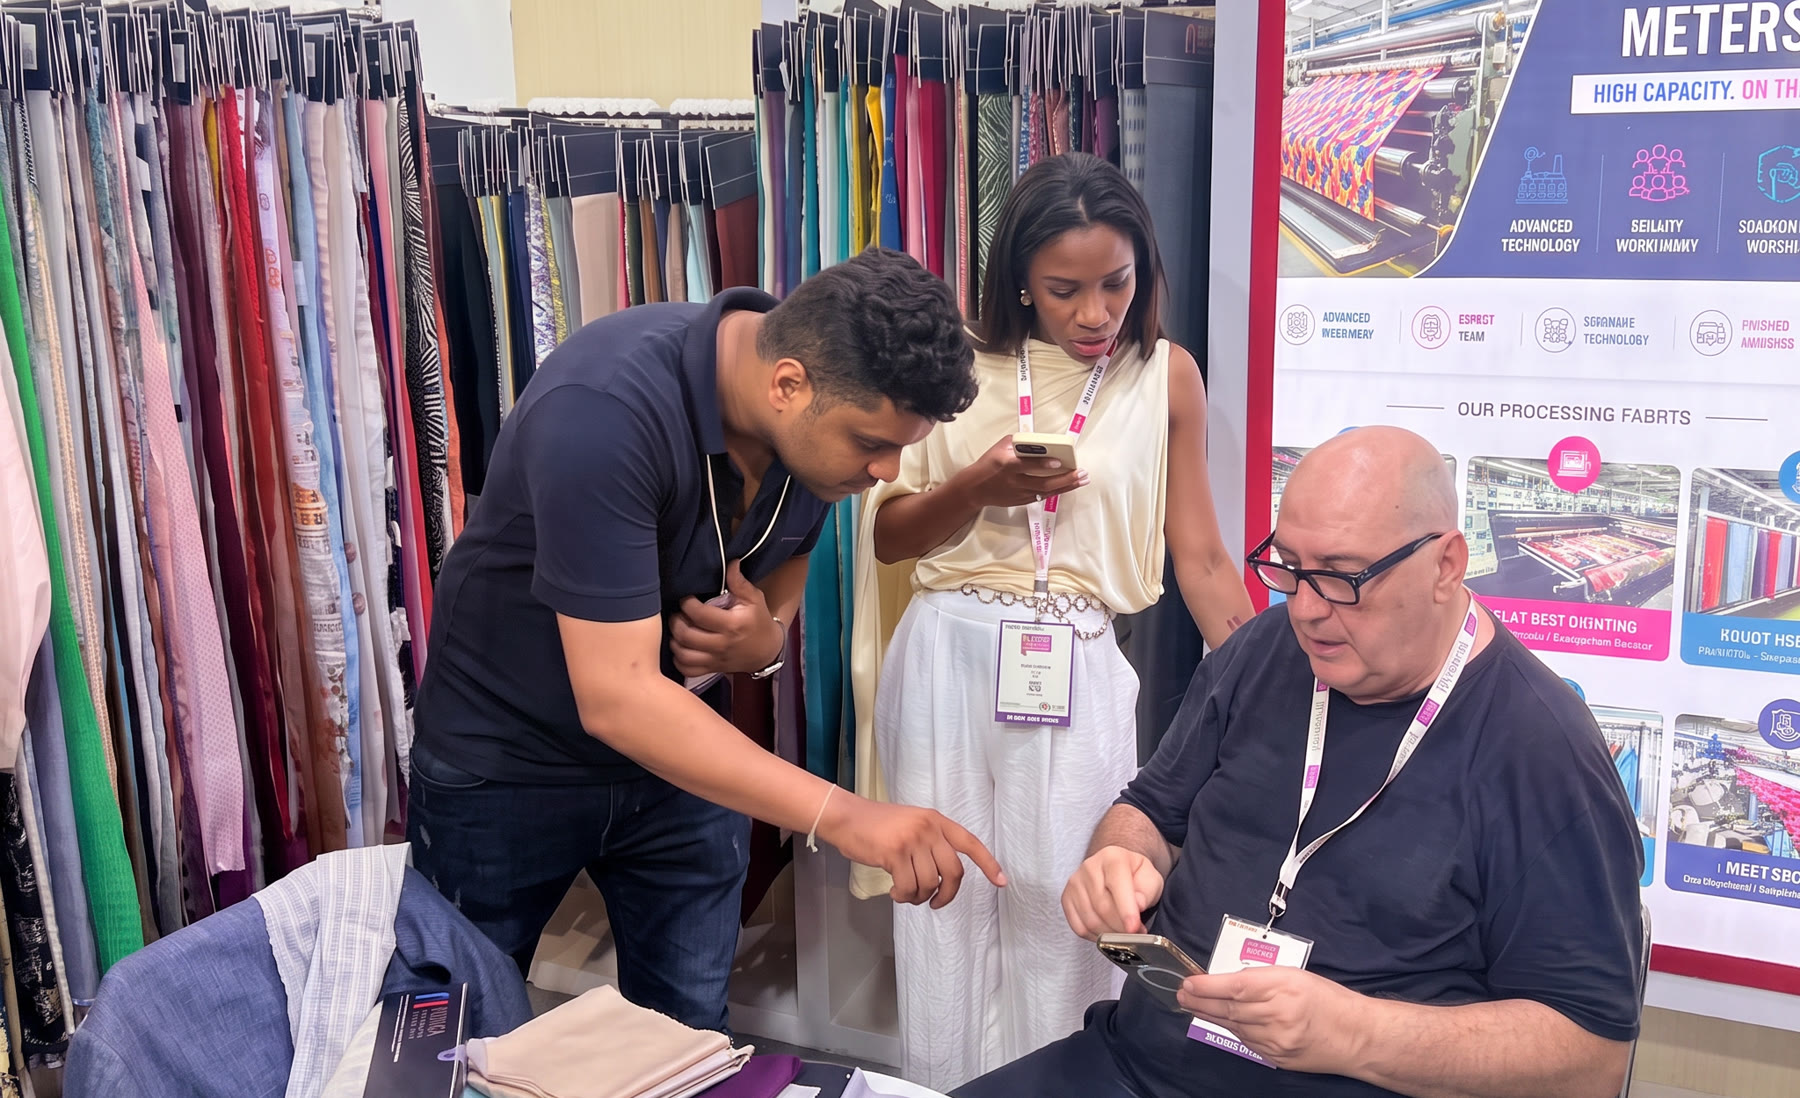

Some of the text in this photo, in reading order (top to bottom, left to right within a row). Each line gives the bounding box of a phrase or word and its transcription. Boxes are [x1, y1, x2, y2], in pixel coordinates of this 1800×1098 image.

[1621, 0, 1800, 57] METERS
[1593, 78, 1800, 103] HIGH CAPACITY. ON TH
[1509, 219, 1573, 233] ADVANCED
[1501, 238, 1581, 253] TECHNOLOGY
[1322, 312, 1371, 323] ADVANCED
[1458, 331, 1485, 342] TEAM
[1458, 402, 1691, 425] OUR PROCESSING FABRTS
[1531, 612, 1566, 628] BEST
[1726, 861, 1770, 880] MEET
